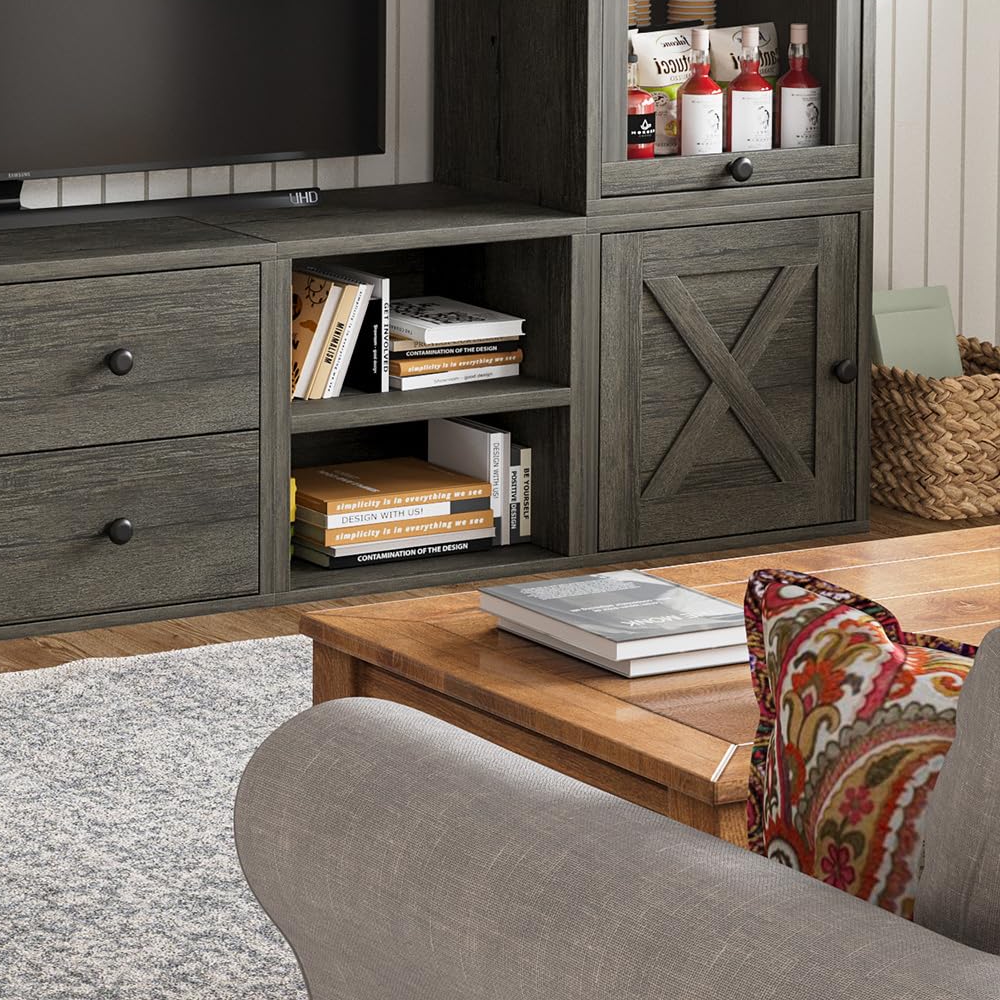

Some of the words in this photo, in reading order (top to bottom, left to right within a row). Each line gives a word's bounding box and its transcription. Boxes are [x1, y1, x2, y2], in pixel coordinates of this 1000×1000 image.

[289, 190, 318, 204] UHD
[324, 321, 344, 365] MINIMALISM
[405, 348, 454, 357] CONTAMINATION
[476, 345, 498, 353] DESIGN
[408, 361, 441, 373] simplicity
[458, 357, 493, 368] everything
[464, 373, 476, 381] good
[477, 371, 494, 379] design
[492, 468, 500, 487] WITH
[523, 468, 530, 479] BE
[336, 498, 381, 511] simplicity
[383, 497, 391, 505] is
[393, 496, 402, 504] in
[405, 491, 451, 503] everything
[492, 488, 500, 499] US!
[341, 513, 377, 524] DESIGN
[380, 510, 406, 519] WITH
[407, 507, 424, 517] US!
[335, 528, 380, 541] simplicity
[383, 527, 391, 535] is
[393, 526, 402, 534] in
[405, 519, 452, 533] everything
[454, 519, 467, 527] we
[469, 517, 485, 525] see
[357, 549, 416, 562] CONTAMINATION
[417, 546, 427, 555] OF
[428, 545, 442, 553] THE
[442, 542, 469, 552] DESIGN
